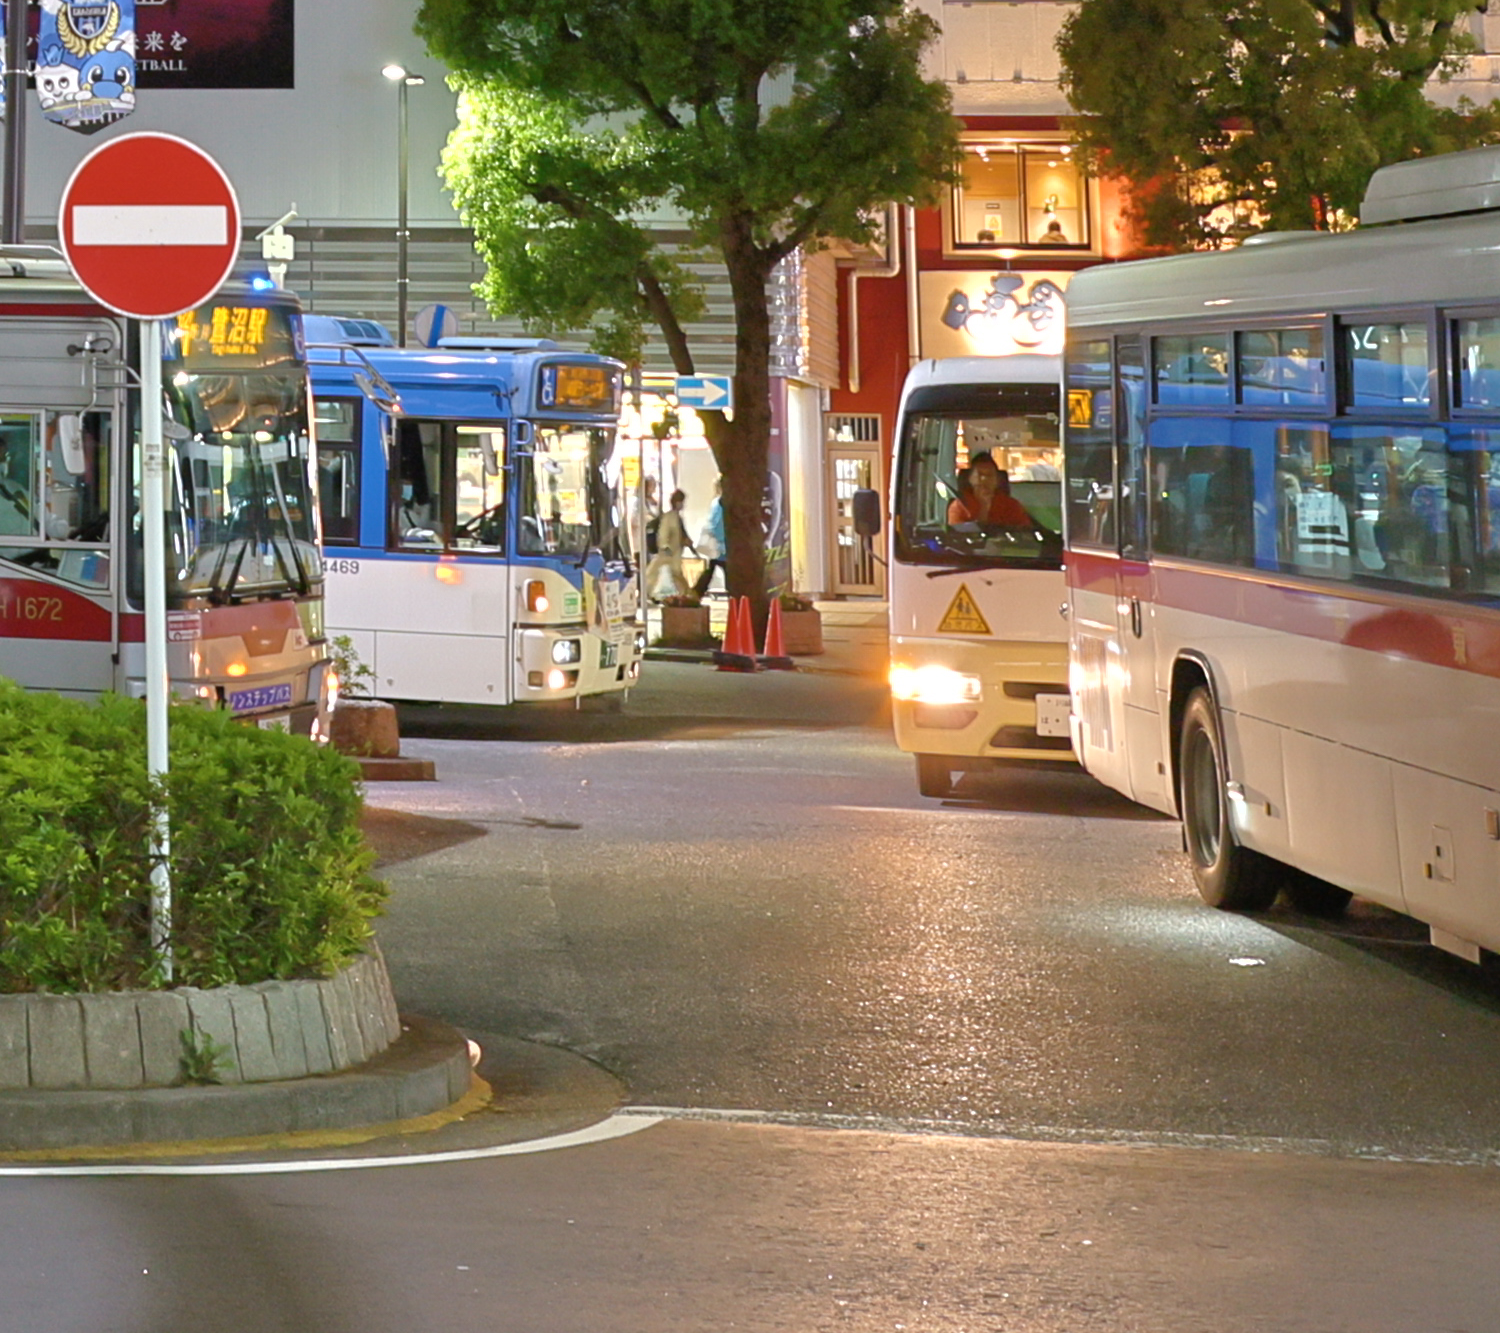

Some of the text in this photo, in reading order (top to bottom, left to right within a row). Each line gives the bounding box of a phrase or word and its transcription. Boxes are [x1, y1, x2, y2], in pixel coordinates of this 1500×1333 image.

[229, 684, 292, 710] ノンステップバス
